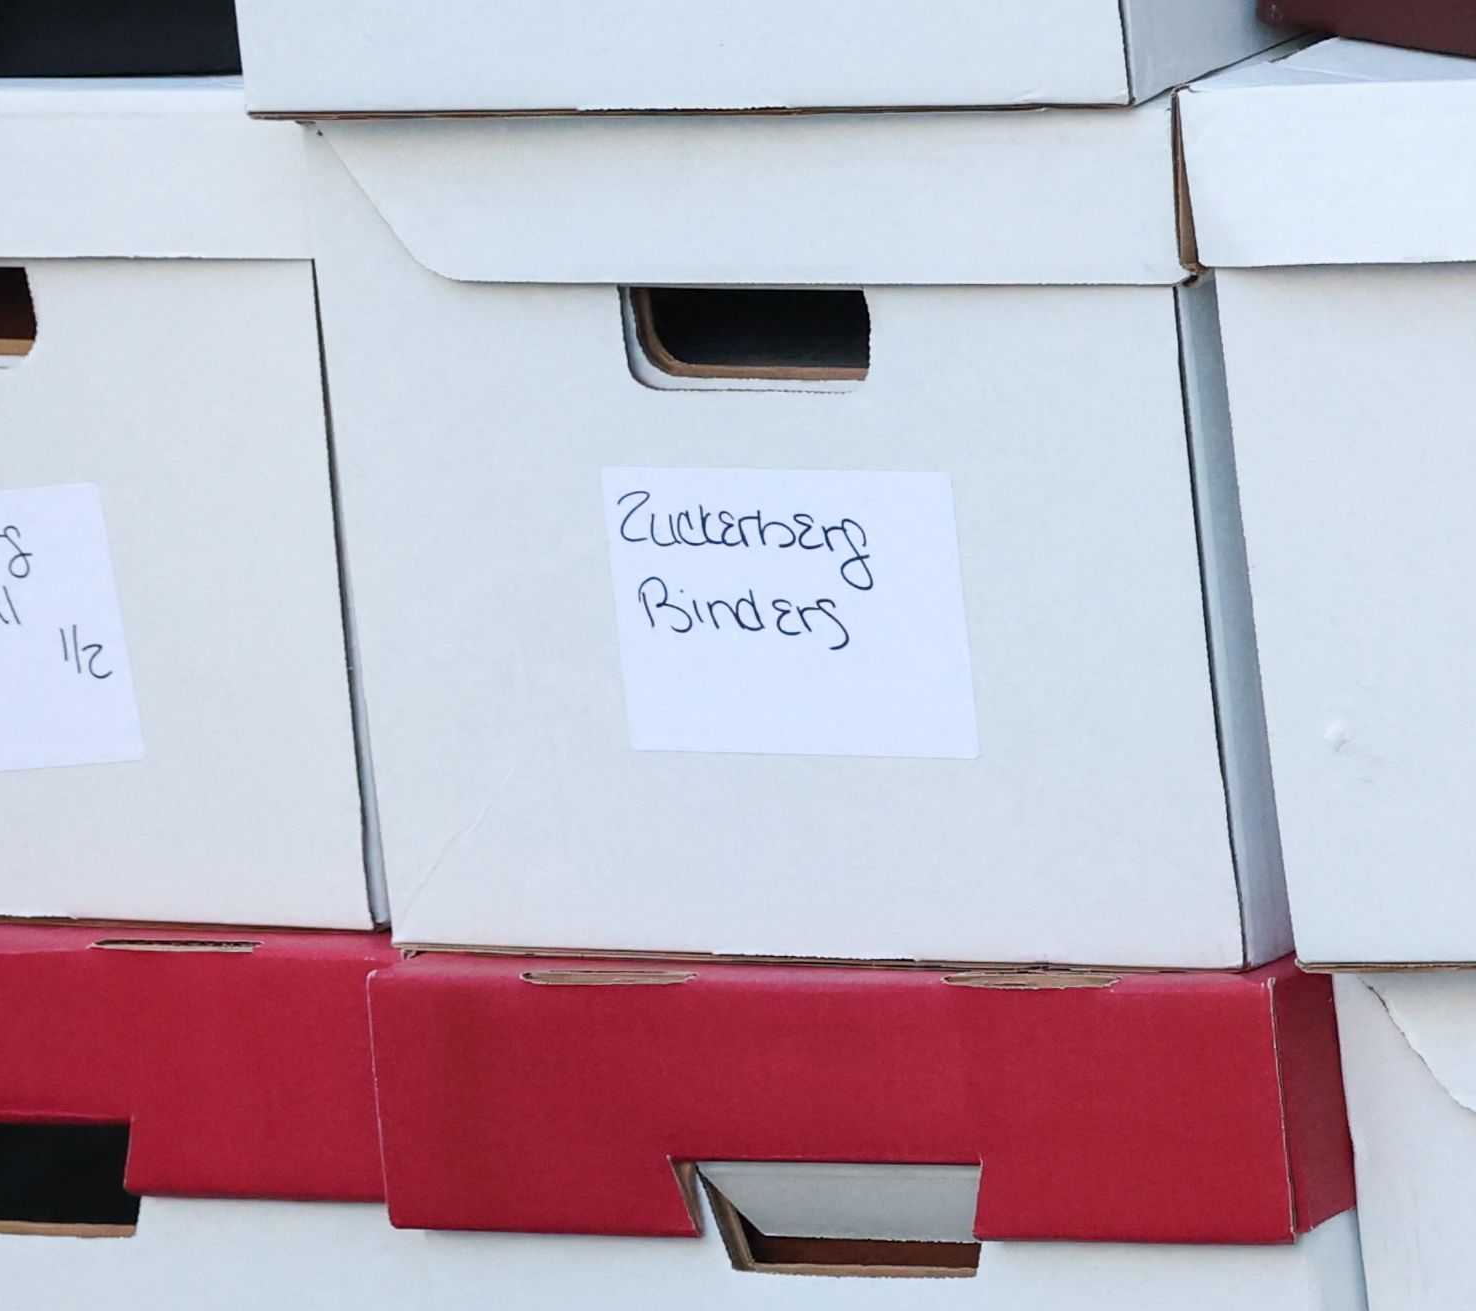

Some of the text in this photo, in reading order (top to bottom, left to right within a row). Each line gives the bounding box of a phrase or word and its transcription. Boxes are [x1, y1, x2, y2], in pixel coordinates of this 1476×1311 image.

[617, 491, 874, 590] Zuckerberg
[638, 576, 850, 650] Binders
[59, 624, 113, 679] 1/2
